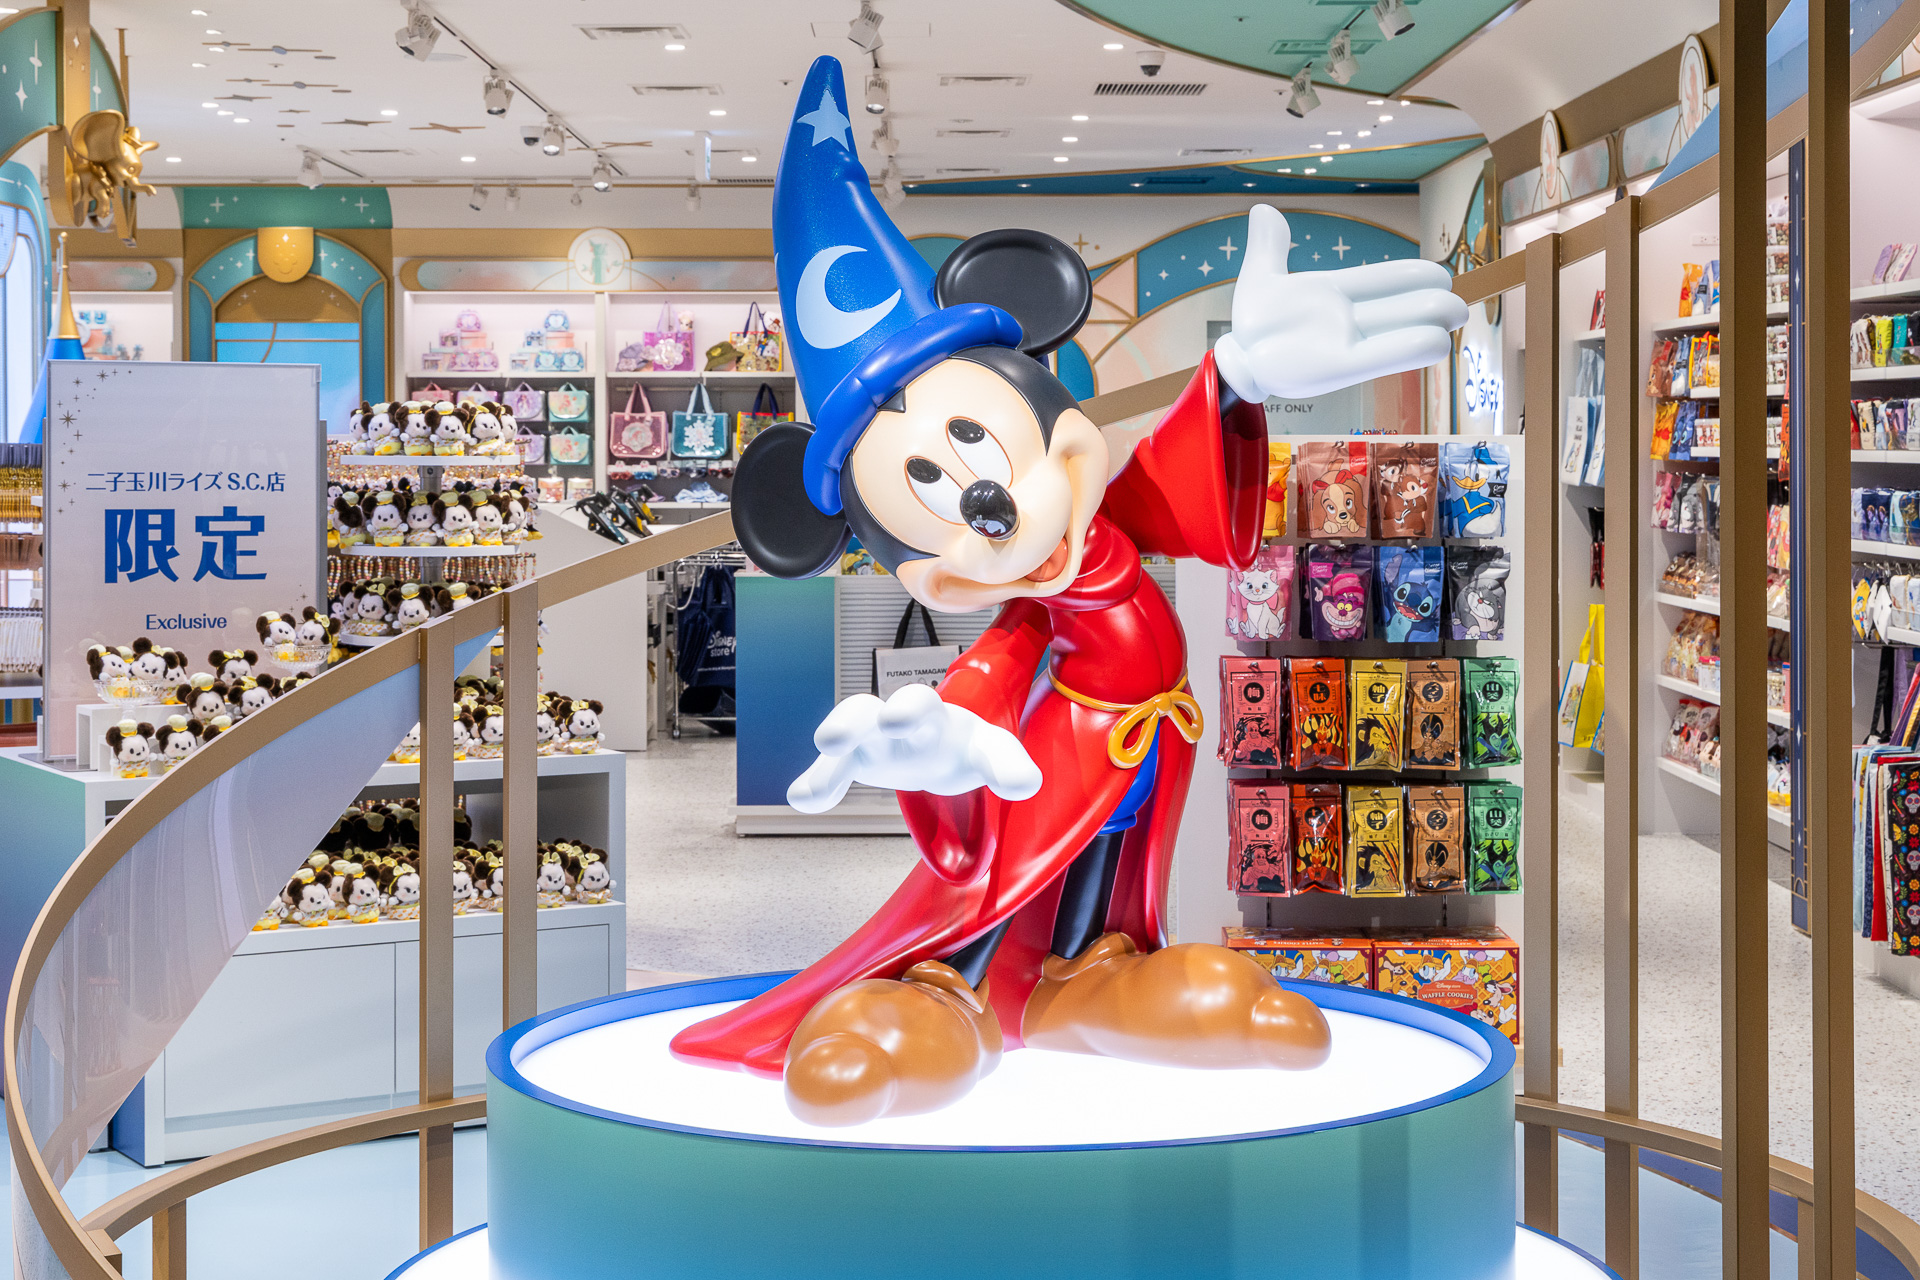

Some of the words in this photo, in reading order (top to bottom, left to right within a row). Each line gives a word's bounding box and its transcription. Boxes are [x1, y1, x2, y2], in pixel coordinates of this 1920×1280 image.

[1265, 404, 1281, 413] AFF
[1284, 403, 1314, 413] ONLY
[104, 506, 267, 583] 限定
[146, 613, 227, 630] Exclusive
[710, 647, 730, 657] store
[886, 670, 913, 678] FUTAKO
[914, 668, 948, 676] TAMAGAW
